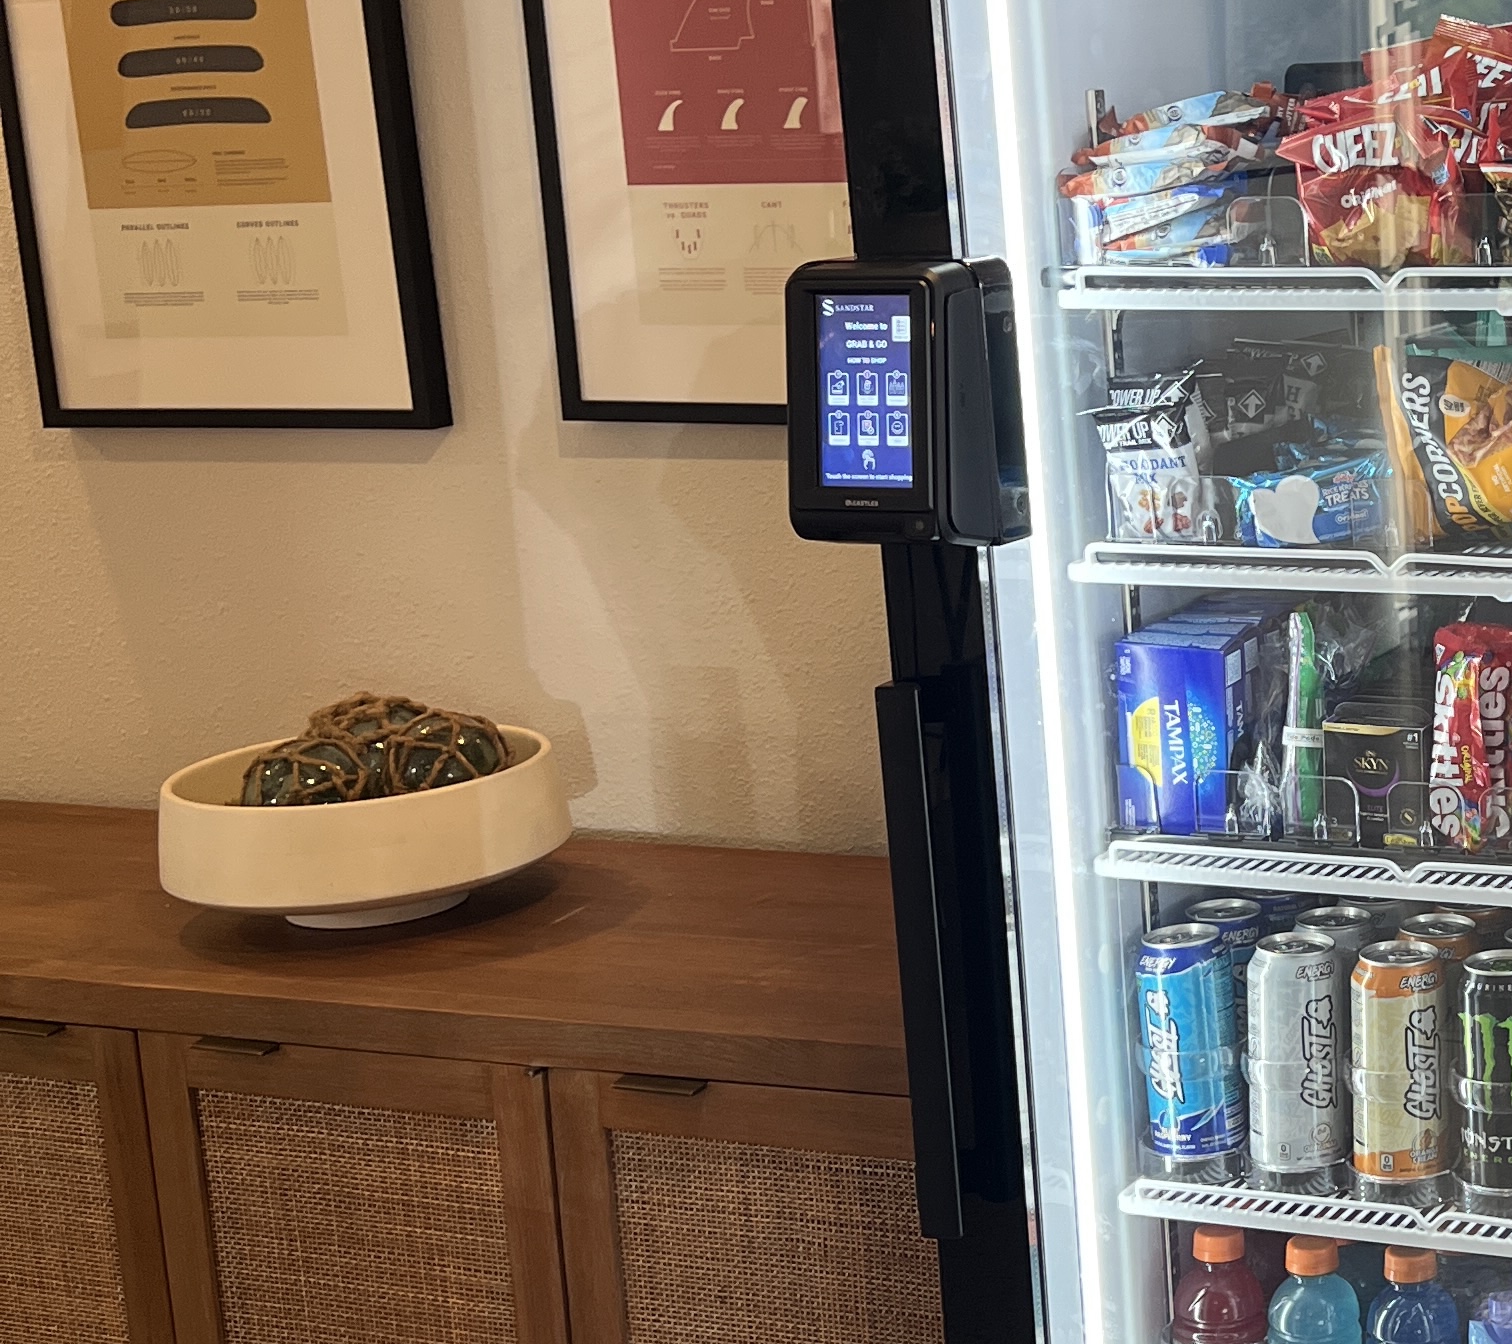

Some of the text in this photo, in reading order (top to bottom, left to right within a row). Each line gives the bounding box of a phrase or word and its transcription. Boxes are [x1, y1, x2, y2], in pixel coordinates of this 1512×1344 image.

[835, 303, 875, 313] SANDSTAR
[844, 320, 889, 331] Welcome to
[845, 339, 868, 349] GRAB
[875, 340, 889, 349] GO
[1323, 487, 1370, 508] TREATS
[1163, 699, 1189, 786] TAMPAX
[1406, 732, 1419, 743] #1
[1353, 756, 1390, 772] SKYN
[1428, 670, 1465, 840] Skittles
[1295, 961, 1336, 981] ENERGY
[1399, 971, 1439, 991] ENERGY
[1300, 1015, 1338, 1109] GHOST
[1403, 1025, 1442, 1122] GHOST
